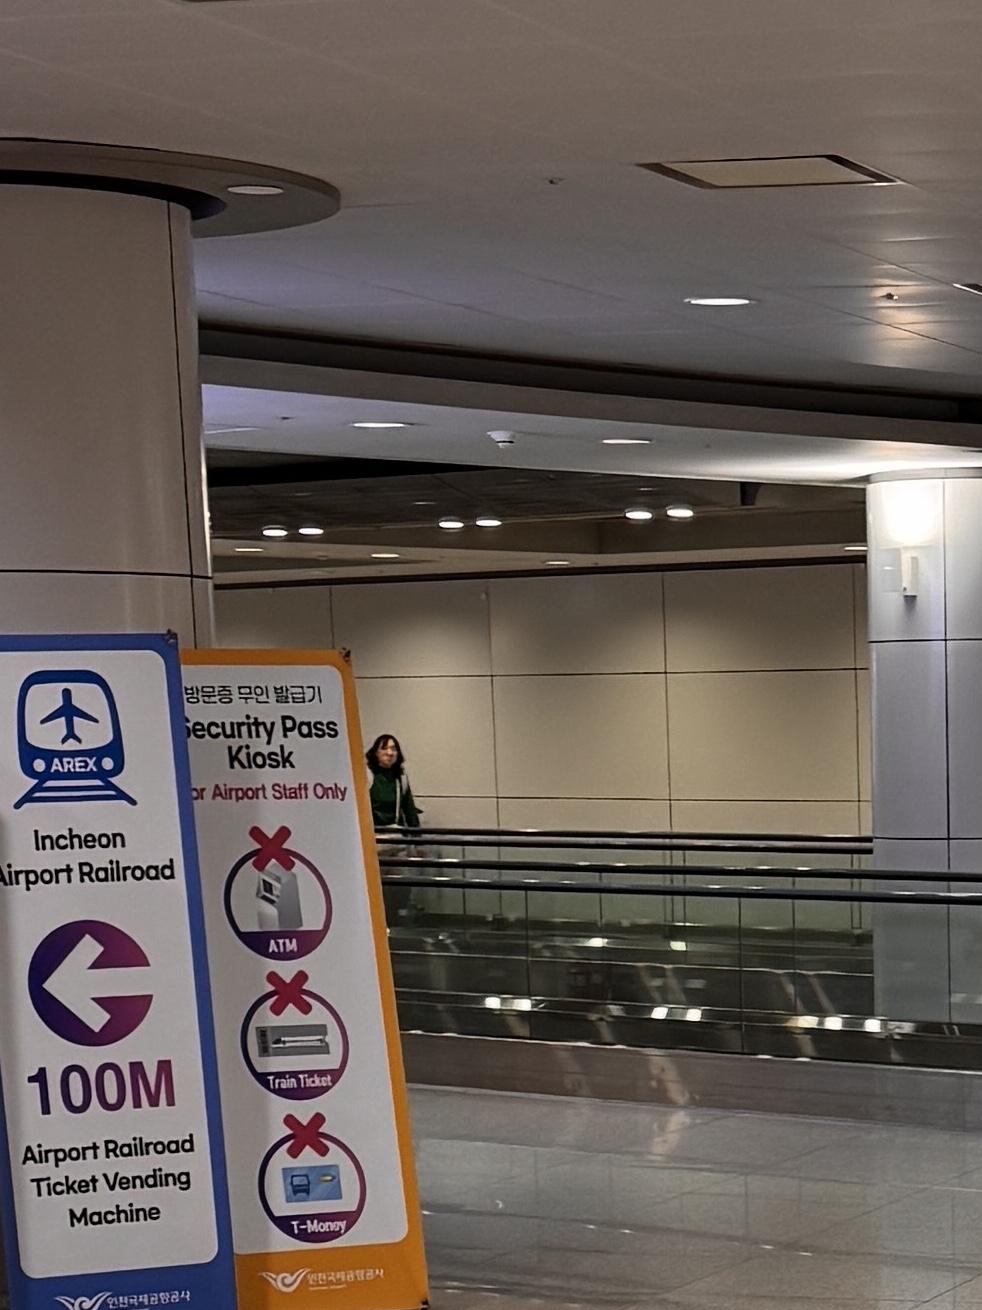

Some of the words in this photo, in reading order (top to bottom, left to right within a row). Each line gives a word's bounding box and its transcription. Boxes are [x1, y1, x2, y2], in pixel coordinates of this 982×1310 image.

[184, 685, 234, 705] 방문증
[238, 685, 270, 704] 무인
[274, 684, 323, 704] 발급기
[281, 714, 339, 739] Pass
[50, 757, 98, 773] AREX
[227, 744, 296, 770] Kiosk
[211, 783, 268, 803] Airport
[272, 782, 309, 800] Staff
[313, 782, 348, 802] Only
[33, 827, 127, 852] Incheon
[78, 857, 176, 883] Railroad
[268, 938, 298, 953] ATM
[27, 1059, 176, 1116] 100M
[266, 1074, 297, 1090] Train
[298, 1073, 333, 1088] Ticket
[22, 1141, 101, 1168] Airport
[104, 1134, 196, 1161] Railroad
[31, 1175, 99, 1198] Ticket
[102, 1167, 191, 1193] Vending
[68, 1204, 161, 1228] Machine
[291, 1218, 347, 1235] T-Money
[106, 1290, 191, 1309] 인천국제공항공사
